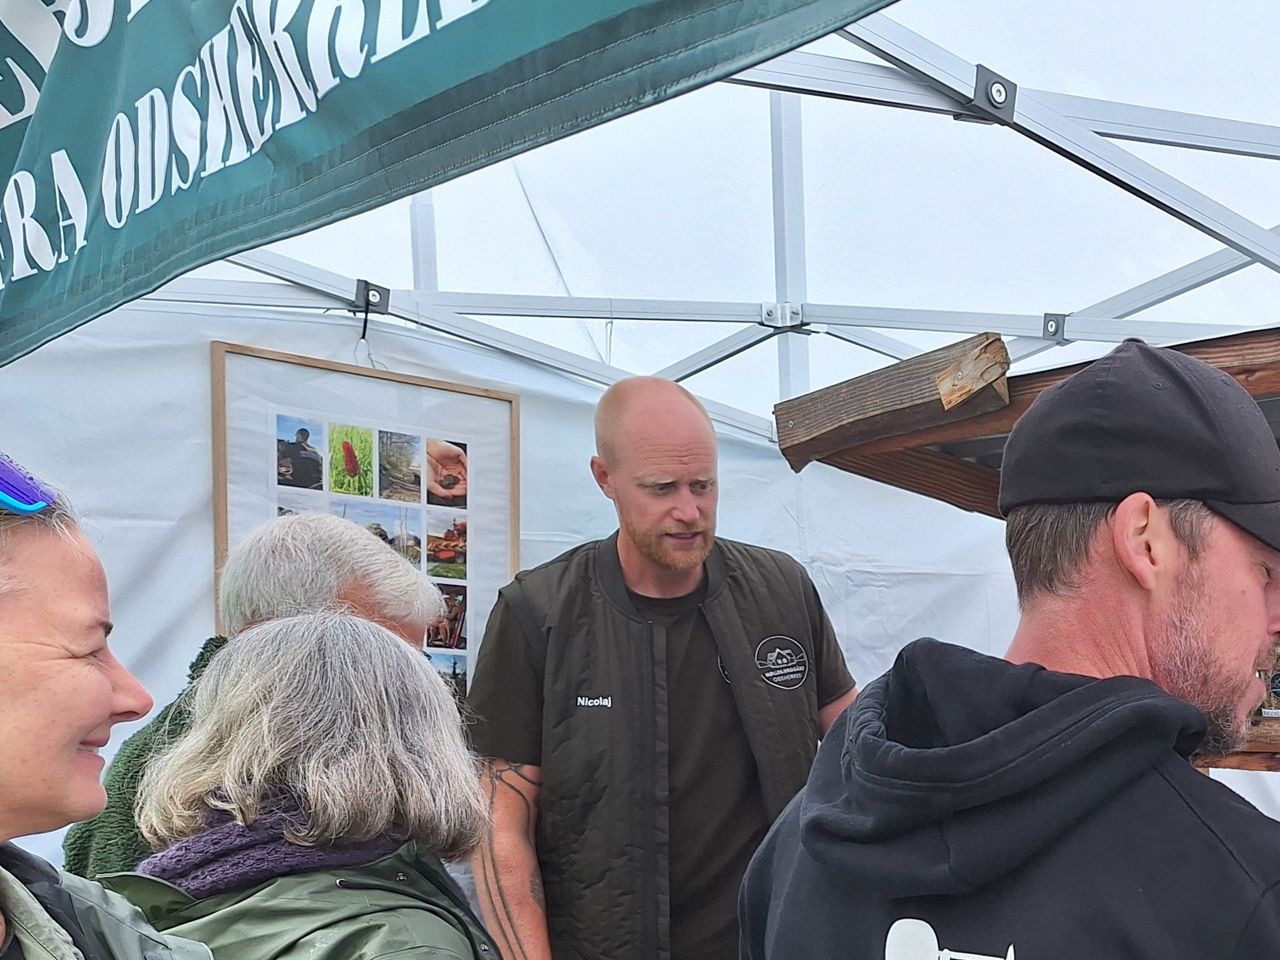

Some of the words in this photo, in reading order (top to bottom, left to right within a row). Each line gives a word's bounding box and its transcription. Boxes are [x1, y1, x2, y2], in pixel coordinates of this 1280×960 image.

[0, 150, 87, 290] RA
[102, 0, 487, 228] ODSHERR
[577, 696, 611, 707] Nicolaj
